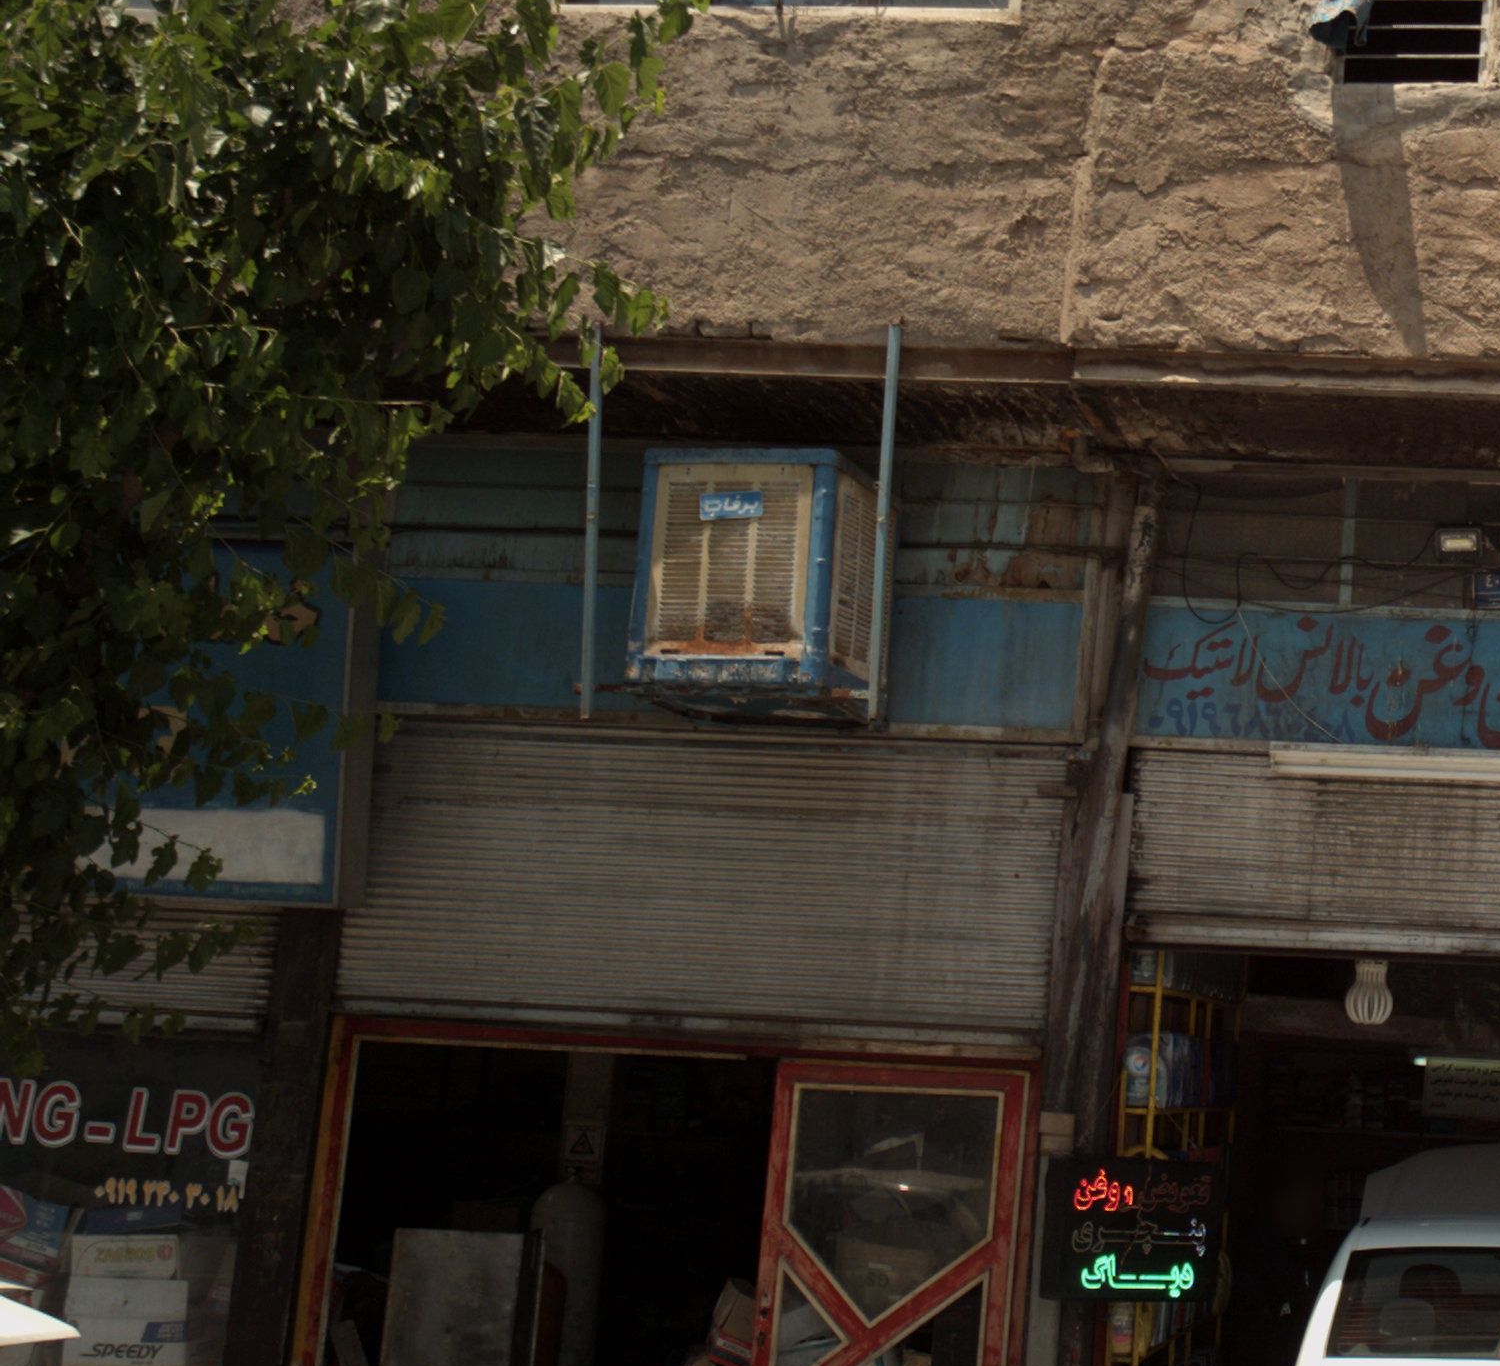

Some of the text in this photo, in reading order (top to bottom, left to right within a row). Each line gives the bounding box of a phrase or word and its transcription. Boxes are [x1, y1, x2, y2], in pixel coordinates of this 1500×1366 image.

[1143, 620, 1260, 700] لاستیک
[1254, 616, 1375, 707] بالانس
[1073, 1166, 1135, 1212] روغن
[80, 1342, 164, 1359] SPEEDY
